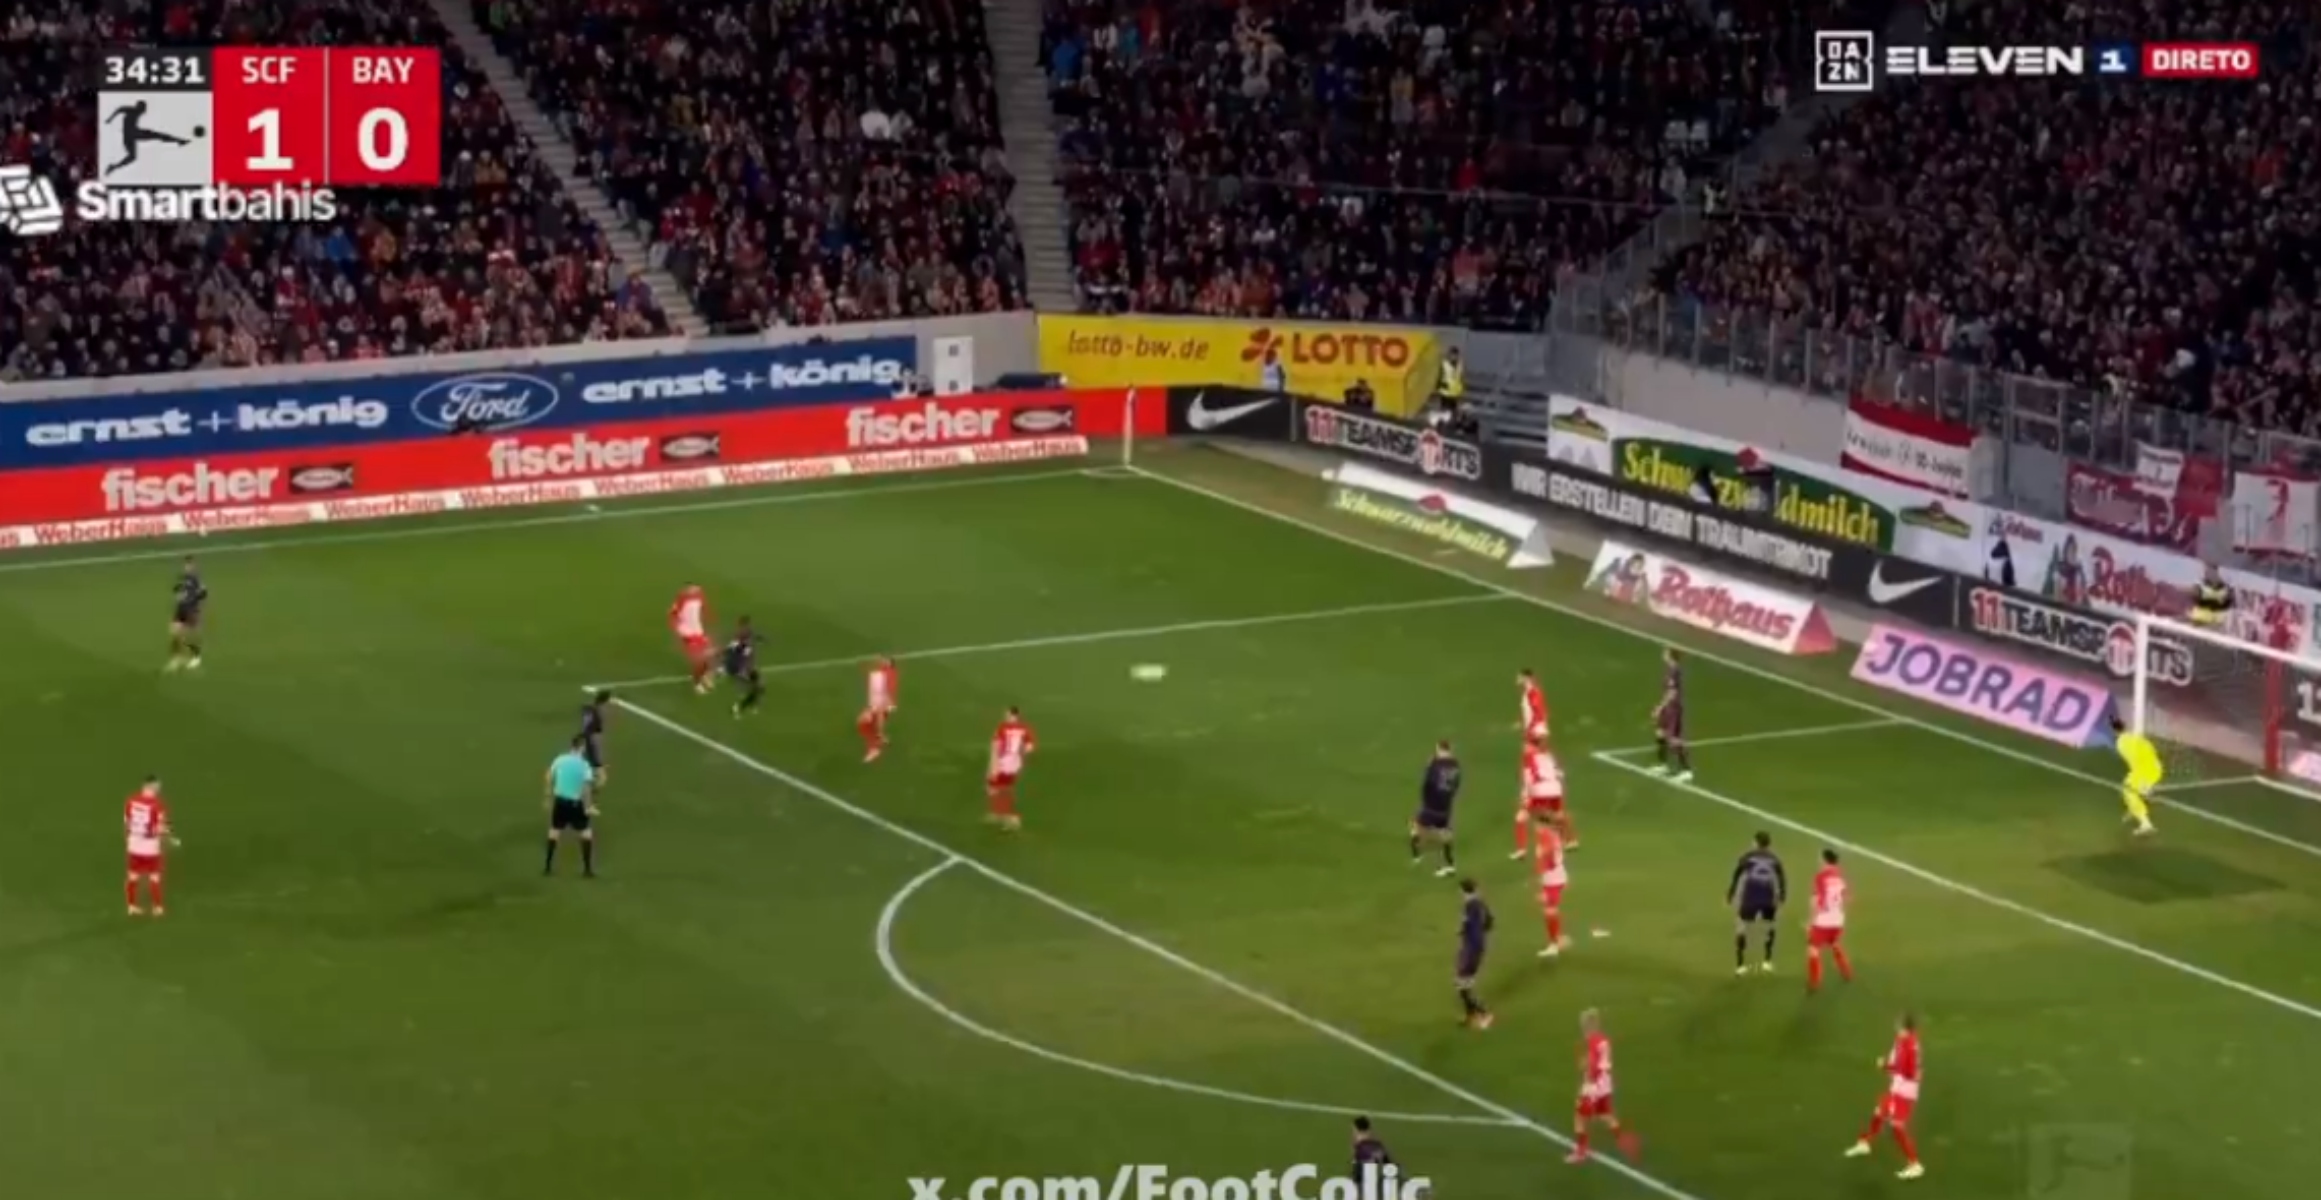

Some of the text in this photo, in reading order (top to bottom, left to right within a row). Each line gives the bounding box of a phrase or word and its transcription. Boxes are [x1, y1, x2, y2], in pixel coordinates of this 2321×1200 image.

[1068, 330, 1209, 361] lotto-bw.de
[1292, 332, 1410, 367] LOTTO
[440, 381, 530, 421] Ford
[582, 367, 727, 403] ernst
[770, 354, 900, 386] könig
[25, 407, 192, 447] ernst
[237, 396, 388, 430] könig
[846, 402, 999, 448] fischer
[487, 432, 650, 481] fischer
[101, 462, 279, 512] fischer
[324, 494, 445, 520] WeberHaus
[459, 482, 580, 509] WeberHaus
[1512, 462, 1546, 497] WIR
[1550, 472, 1645, 528] ERSTELLEN
[1649, 502, 1692, 541] DEIN
[33, 517, 168, 545] WeberHaus
[180, 502, 311, 531] WeberHaus
[1335, 488, 1508, 560] Schwarzwaldmilch
[1651, 564, 1796, 640] Rothaus
[1866, 633, 2092, 732] JOBRAD
